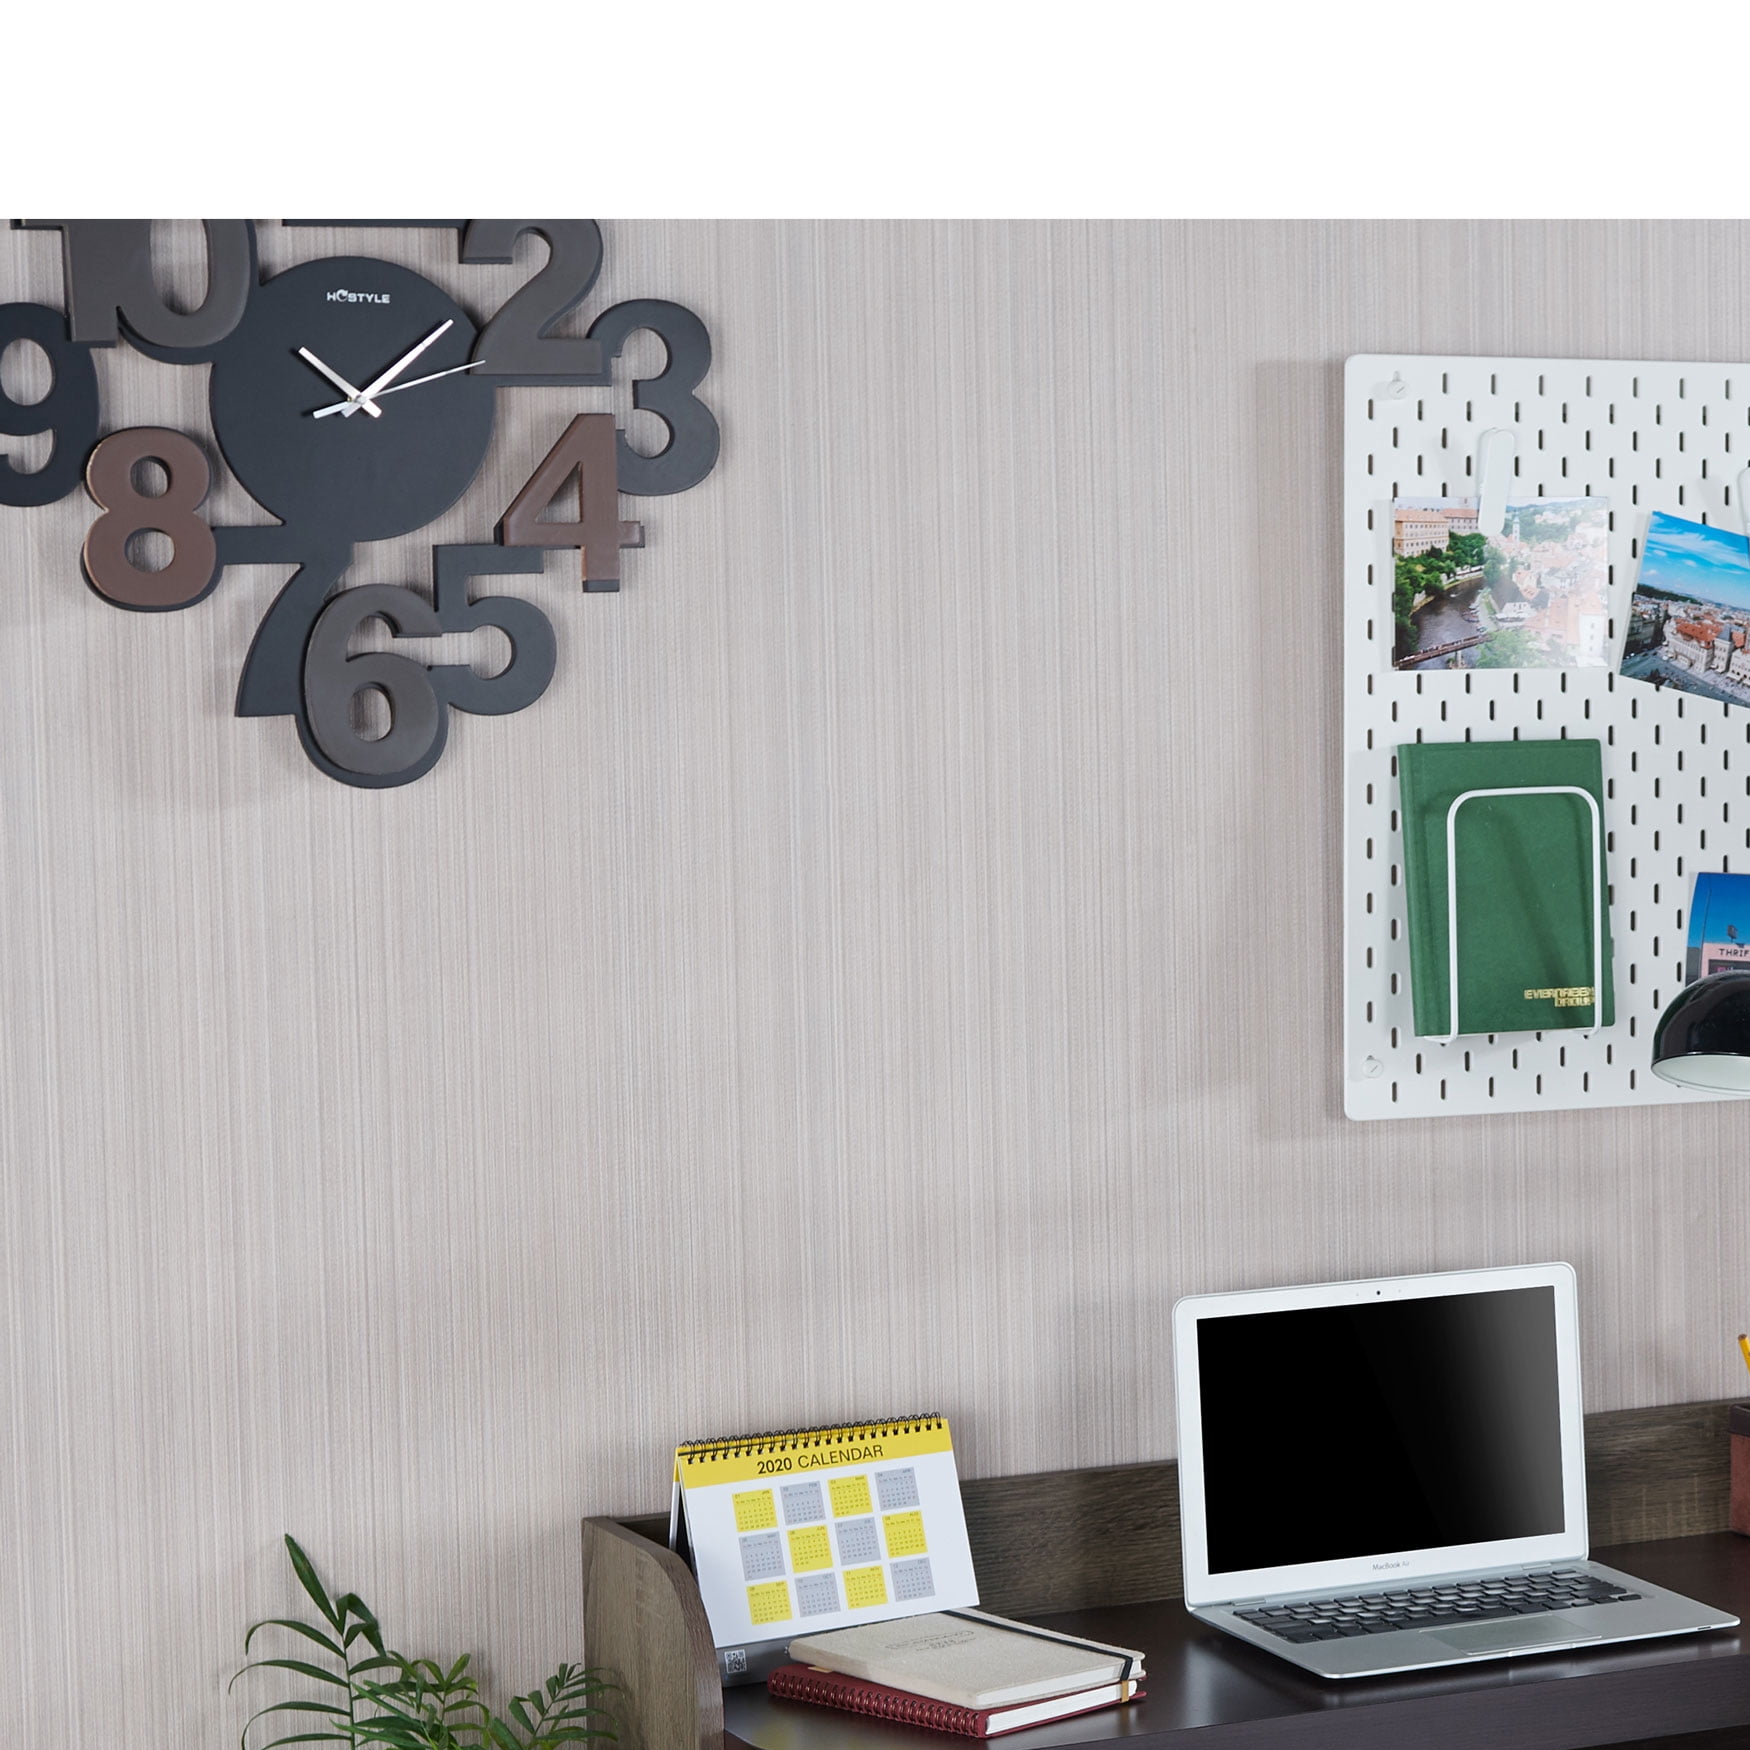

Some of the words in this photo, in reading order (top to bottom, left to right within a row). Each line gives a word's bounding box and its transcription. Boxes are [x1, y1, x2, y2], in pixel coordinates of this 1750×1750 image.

[586, 298, 720, 496] 3
[81, 426, 224, 612] 8
[495, 413, 645, 593] 4
[296, 584, 448, 789] 6
[433, 545, 557, 716] 5
[757, 1457, 792, 1475] 2020
[797, 1444, 884, 1469] CALENDAR
